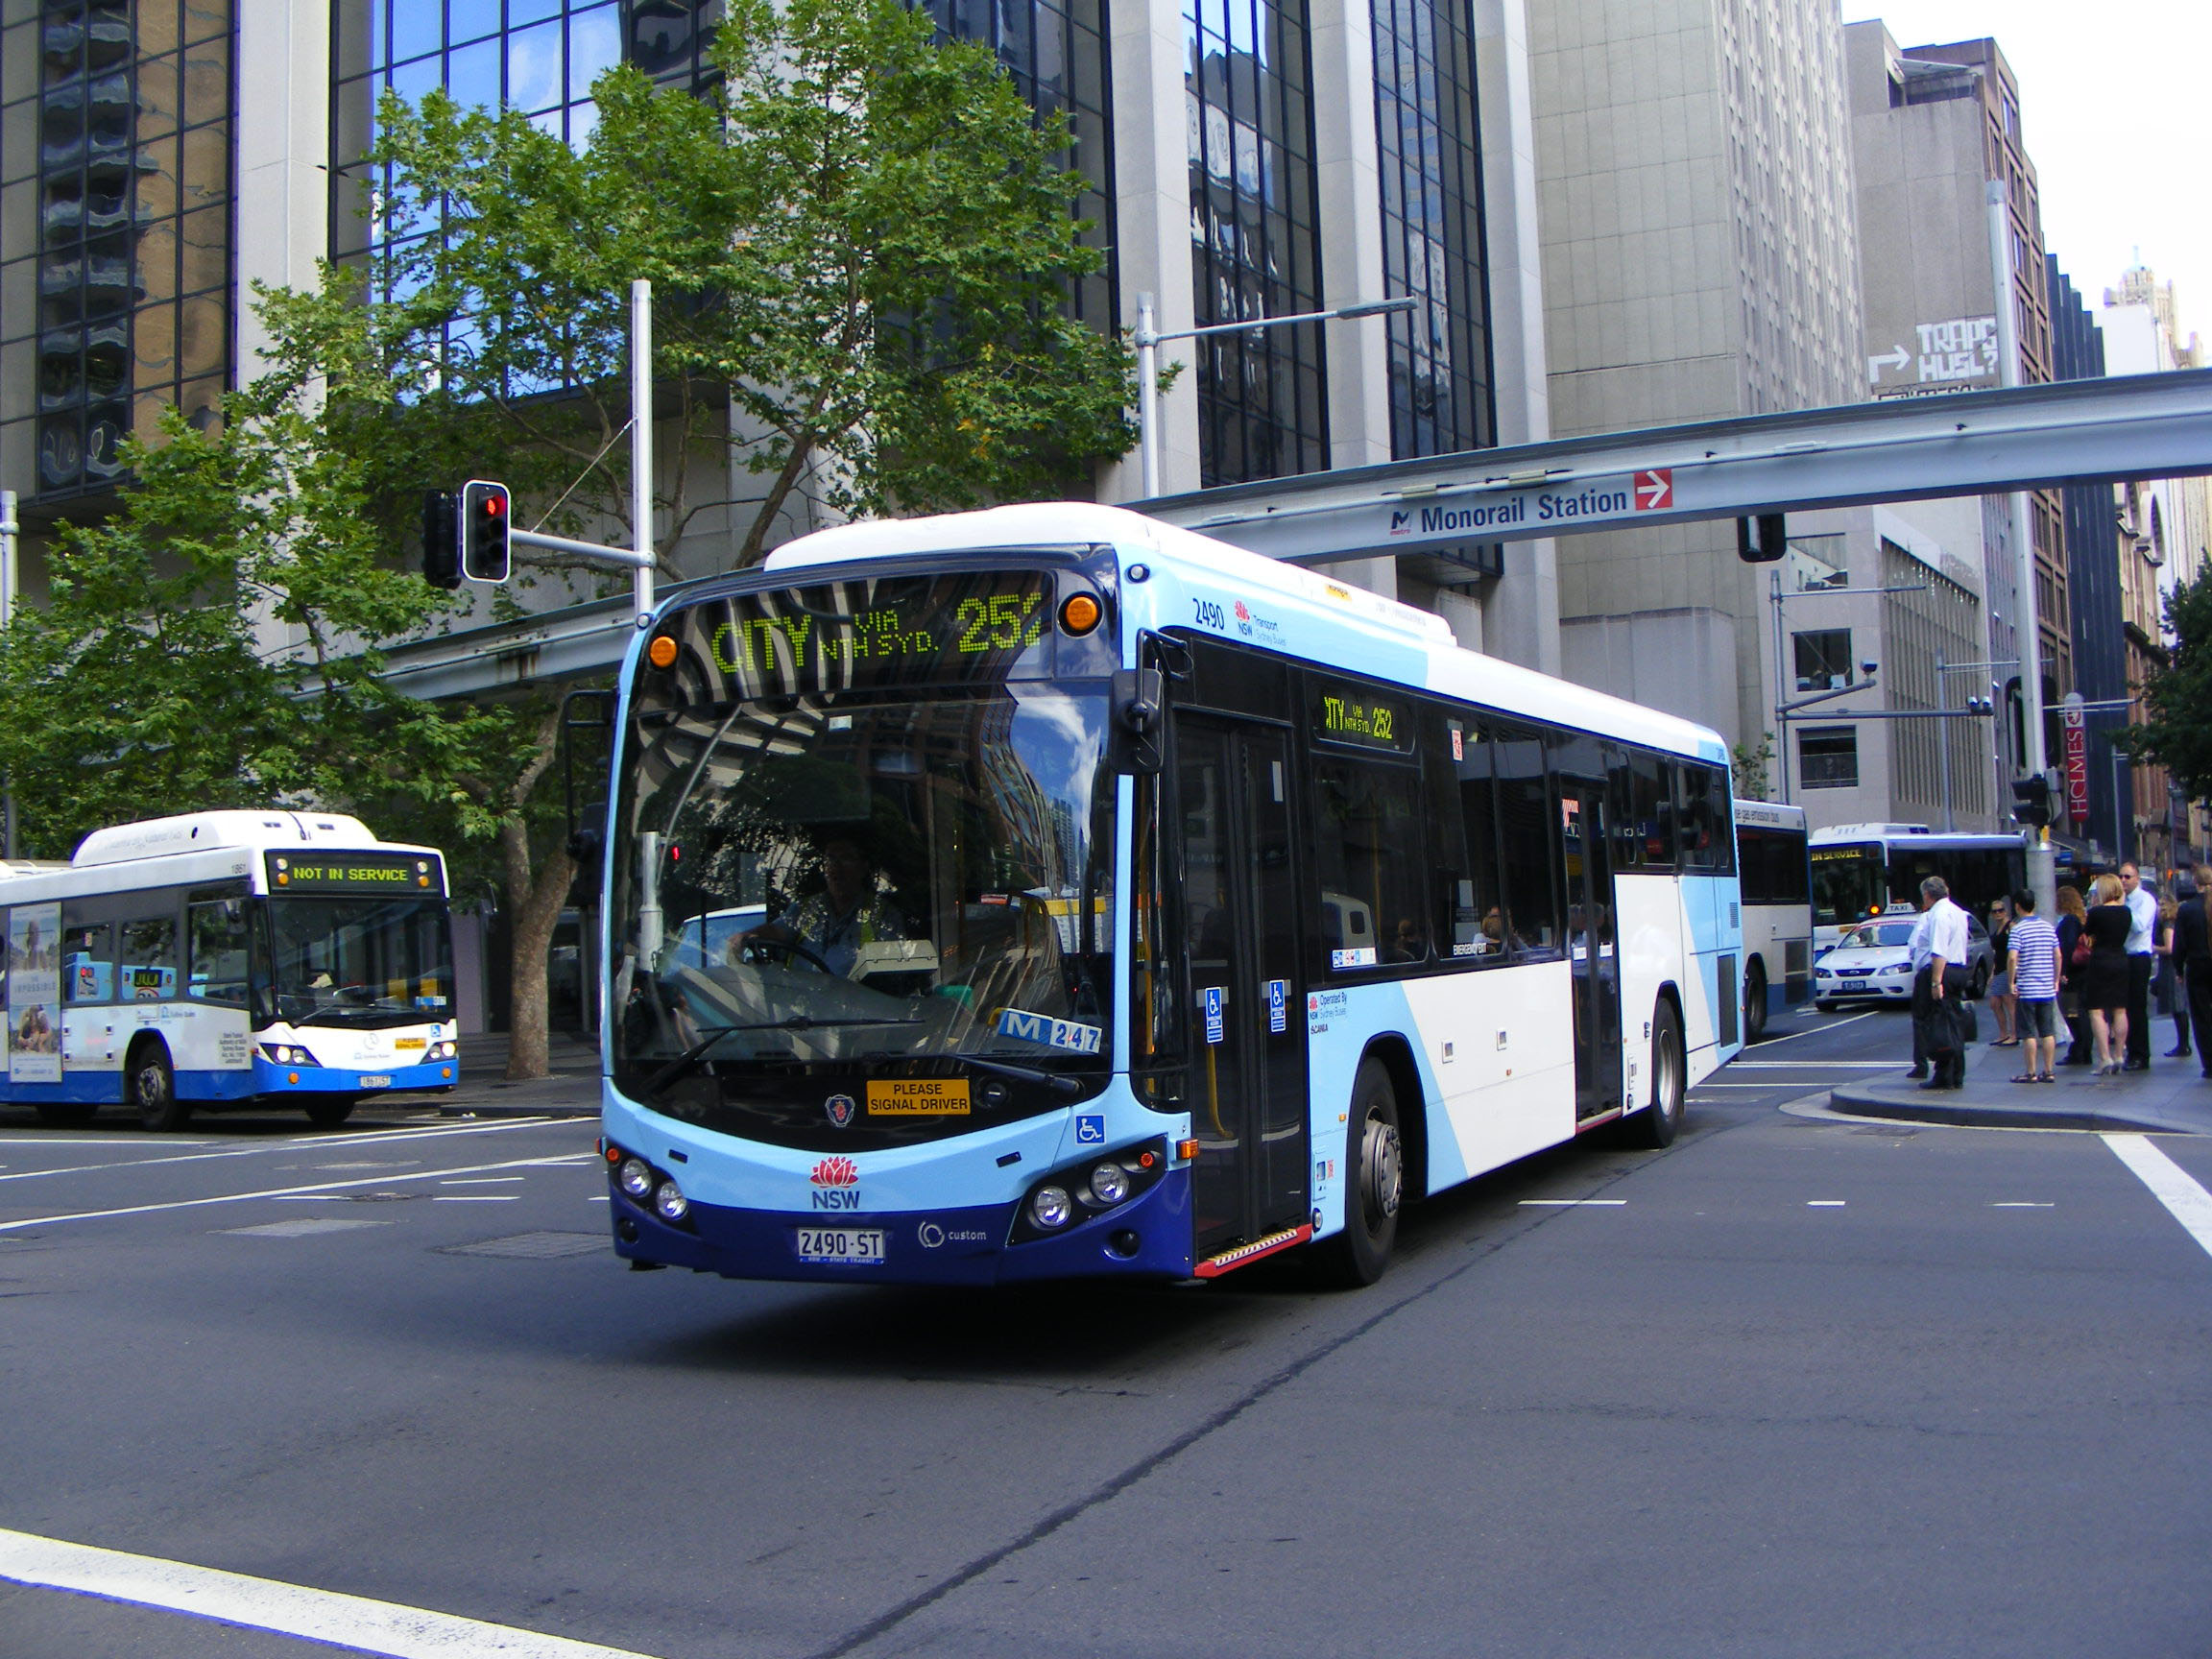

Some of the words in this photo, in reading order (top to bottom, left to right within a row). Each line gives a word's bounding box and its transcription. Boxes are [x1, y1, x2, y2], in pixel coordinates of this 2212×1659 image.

[1422, 497, 1525, 533] Monorail
[1538, 489, 1627, 520] Station
[854, 610, 899, 633] VIA
[1192, 597, 1225, 630] 2490
[1253, 614, 1280, 632] Transport
[711, 614, 812, 673] CITY
[819, 636, 869, 661] NTH
[878, 631, 939, 656] SYD.
[1372, 707, 1392, 739] 252
[2067, 731, 2087, 813] HOLMES
[1811, 853, 1822, 861] IN
[1824, 849, 1863, 860] SERVICE
[293, 867, 323, 879] NOT
[328, 868, 344, 880] IN
[349, 868, 408, 881] SERVICE
[1320, 993, 1341, 1007] Operated
[1006, 1012, 1041, 1040] M
[1055, 1022, 1098, 1050] 247
[894, 1084, 943, 1094] PLEASE
[871, 1098, 918, 1111] SIGNAL
[921, 1097, 968, 1110] DRIVER
[812, 1190, 860, 1209] NSW
[948, 1230, 987, 1240] custom
